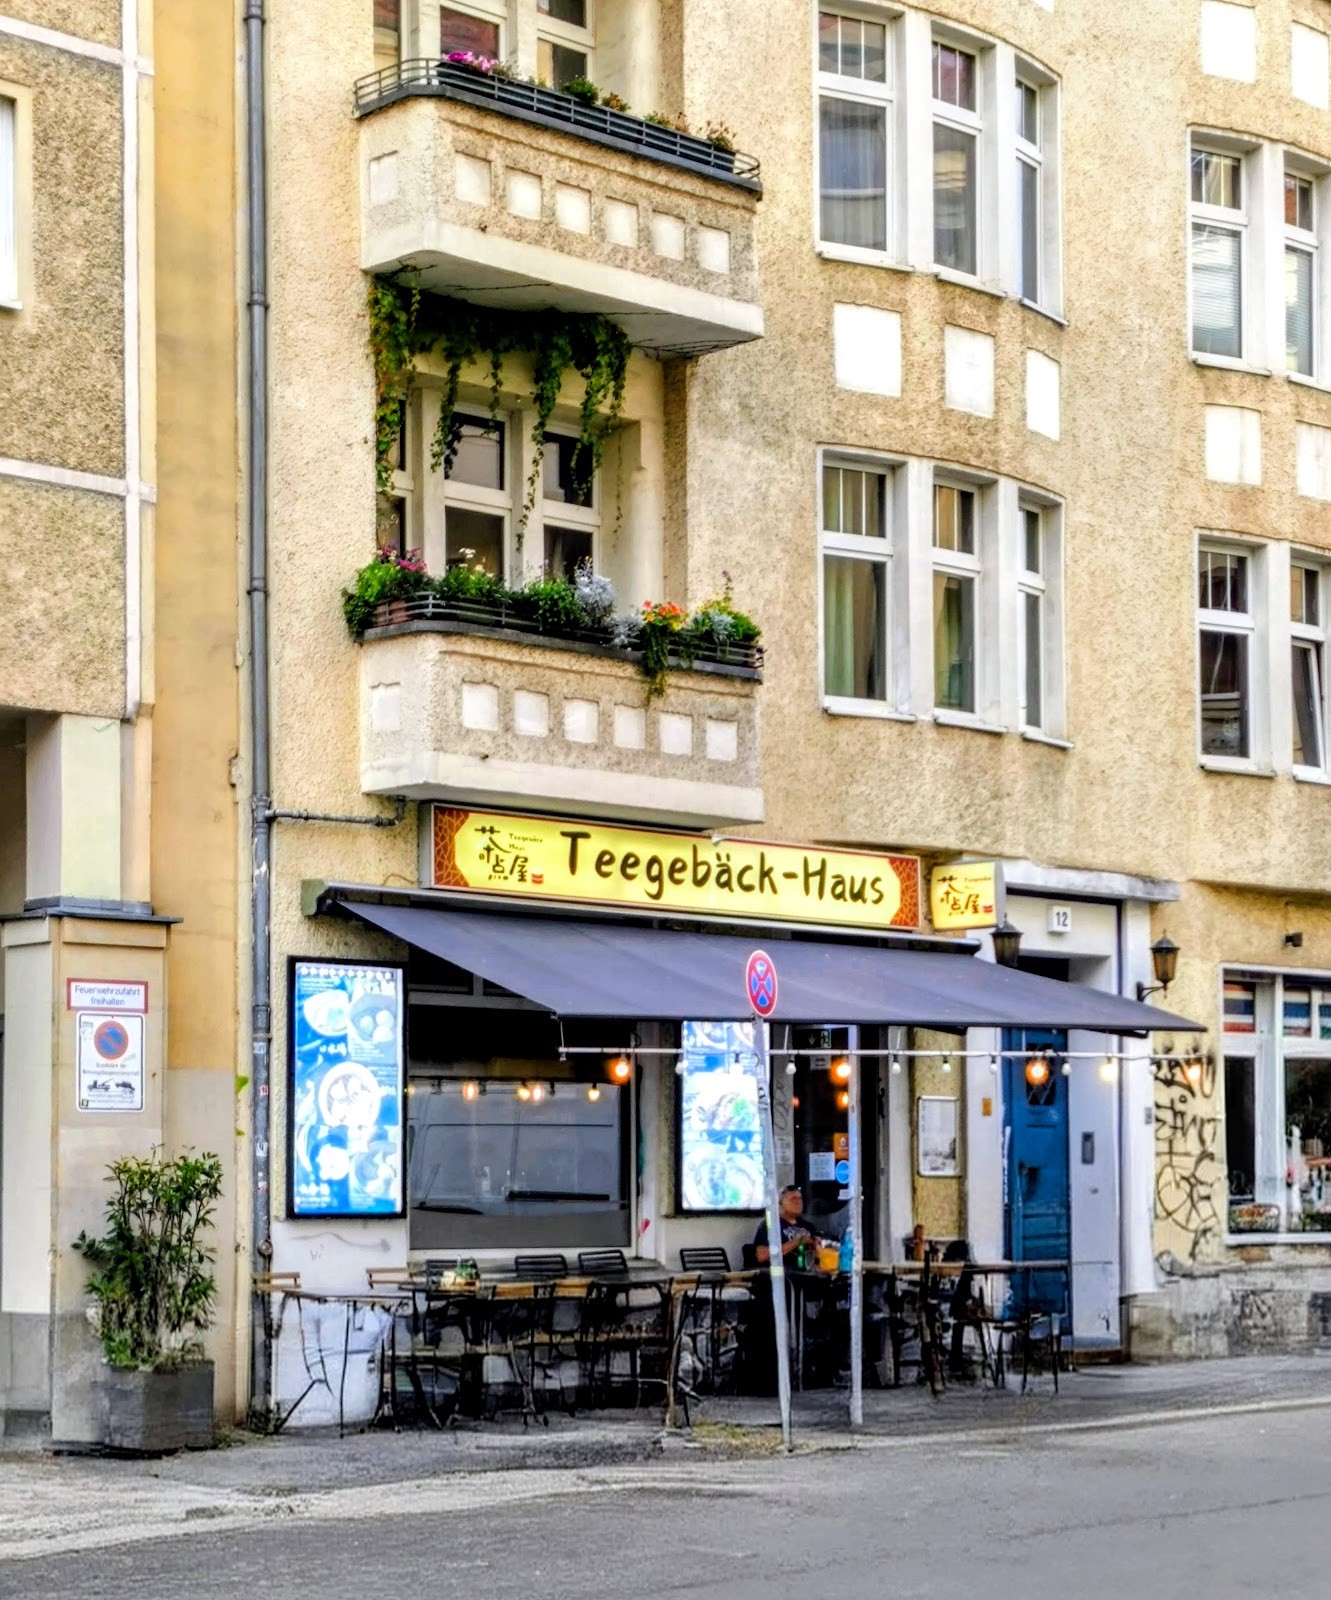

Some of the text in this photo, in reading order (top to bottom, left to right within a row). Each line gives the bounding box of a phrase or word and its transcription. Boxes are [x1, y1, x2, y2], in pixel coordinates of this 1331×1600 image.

[561, 831, 885, 905] Teegebäck-Haus
[1056, 911, 1069, 928] 12
[74, 984, 141, 996] Feuerwehrzufahrt
[90, 996, 125, 1006] freihalten
